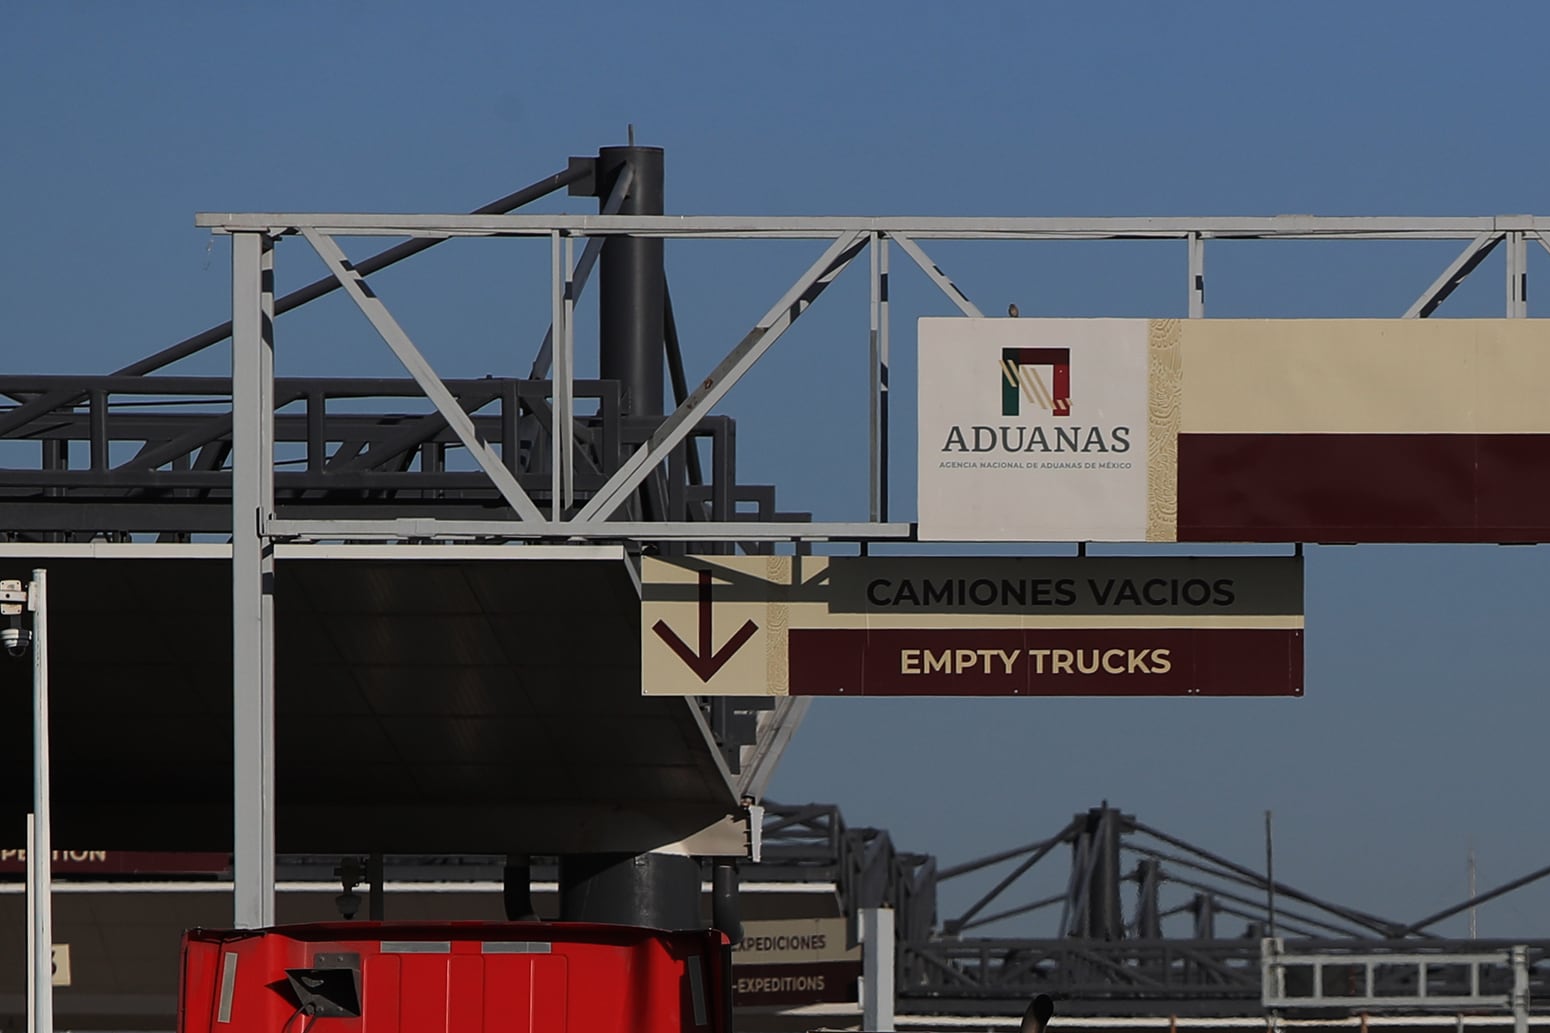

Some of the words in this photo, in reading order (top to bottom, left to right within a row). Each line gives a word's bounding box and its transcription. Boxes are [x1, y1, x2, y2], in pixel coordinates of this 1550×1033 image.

[941, 425, 1131, 453] ADUANAS
[939, 461, 977, 469] AGENCIA
[980, 461, 1025, 469] NACIONAL
[1027, 461, 1038, 469] DE
[1040, 461, 1082, 470] ADUANAS
[1084, 461, 1096, 470] DE
[1098, 459, 1132, 470] MÉXICO
[866, 577, 1077, 607] CAMIONES
[1085, 577, 1237, 607] VACIOS
[900, 649, 1022, 675] EMPTY
[1028, 648, 1172, 675] TRUCKS
[732, 935, 827, 952] XPEDICIONES
